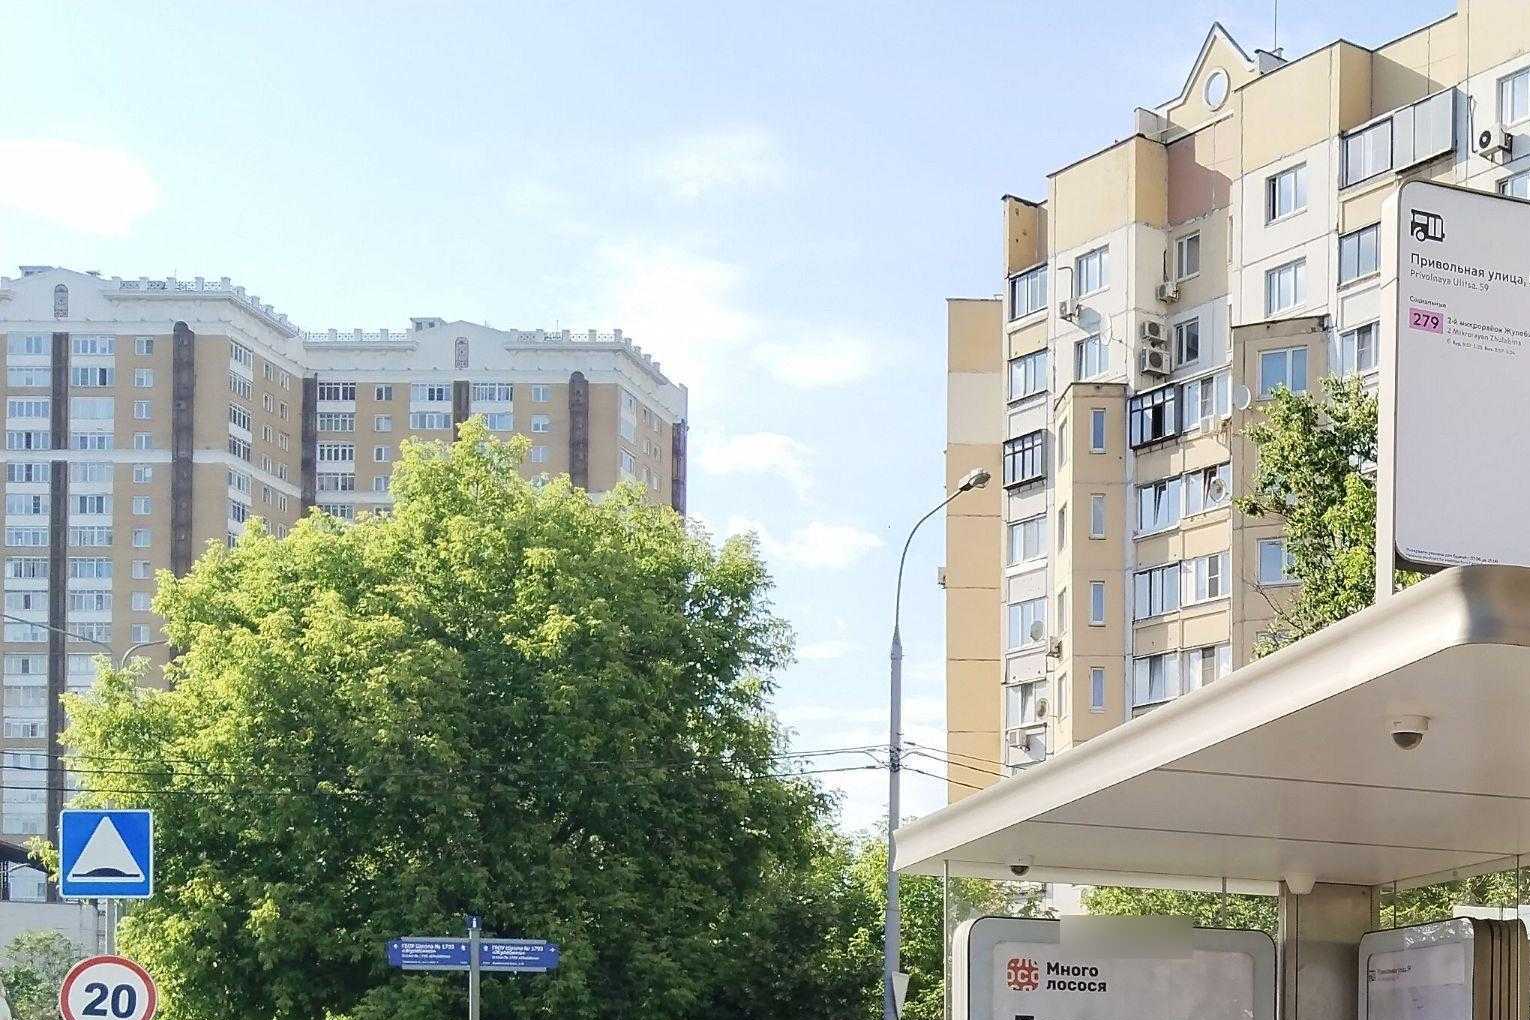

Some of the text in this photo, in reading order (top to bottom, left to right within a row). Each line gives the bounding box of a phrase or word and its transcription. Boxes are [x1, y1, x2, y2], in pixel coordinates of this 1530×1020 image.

[1411, 253, 1485, 278] Привольная
[1488, 270, 1526, 287] улица,
[1410, 269, 1451, 285] Privolnaya
[1479, 283, 1489, 292] 59
[1413, 313, 1440, 329] 279
[1046, 962, 1099, 977] Много
[1046, 979, 1107, 992] лосося
[82, 982, 137, 1019] 20
